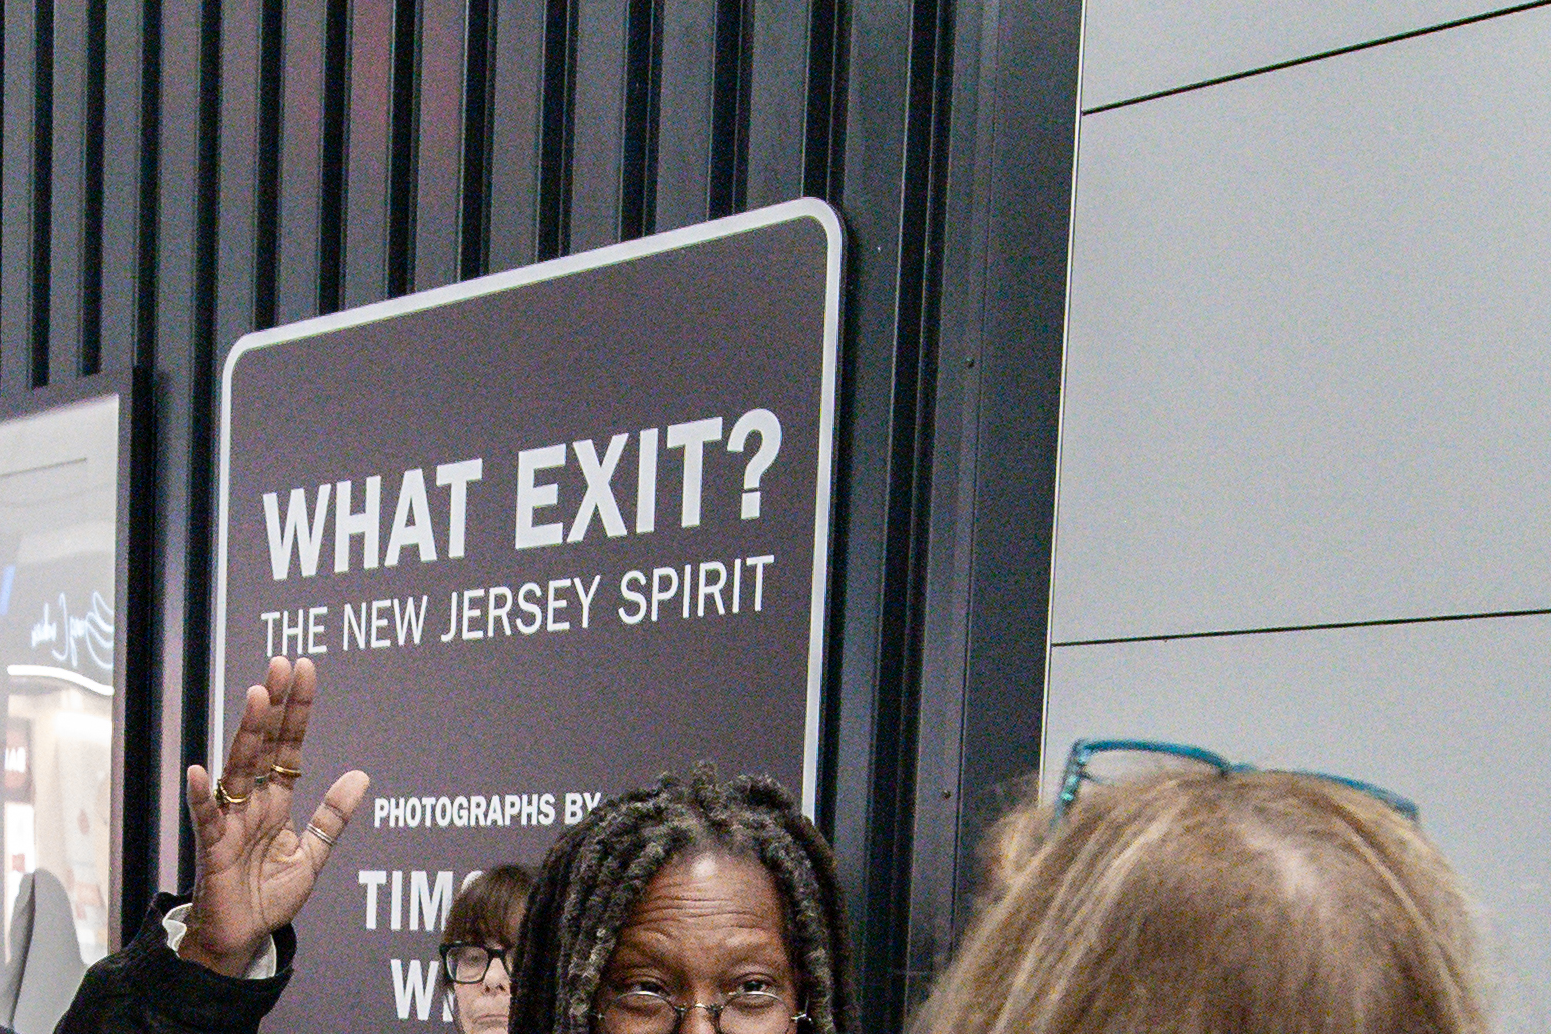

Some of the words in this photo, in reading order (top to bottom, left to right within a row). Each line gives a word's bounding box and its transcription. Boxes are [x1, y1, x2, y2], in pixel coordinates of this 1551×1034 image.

[262, 457, 484, 581] WHAT
[513, 407, 783, 550] EXIT?
[261, 606, 328, 657] THE
[342, 594, 428, 652] NEW
[440, 574, 602, 644] JERSEY
[618, 554, 776, 625] SPIRIT
[374, 794, 556, 828] PHOTOGRAPHS
[564, 792, 602, 825] BY
[358, 870, 483, 932] TIM
[390, 958, 455, 1023] W
